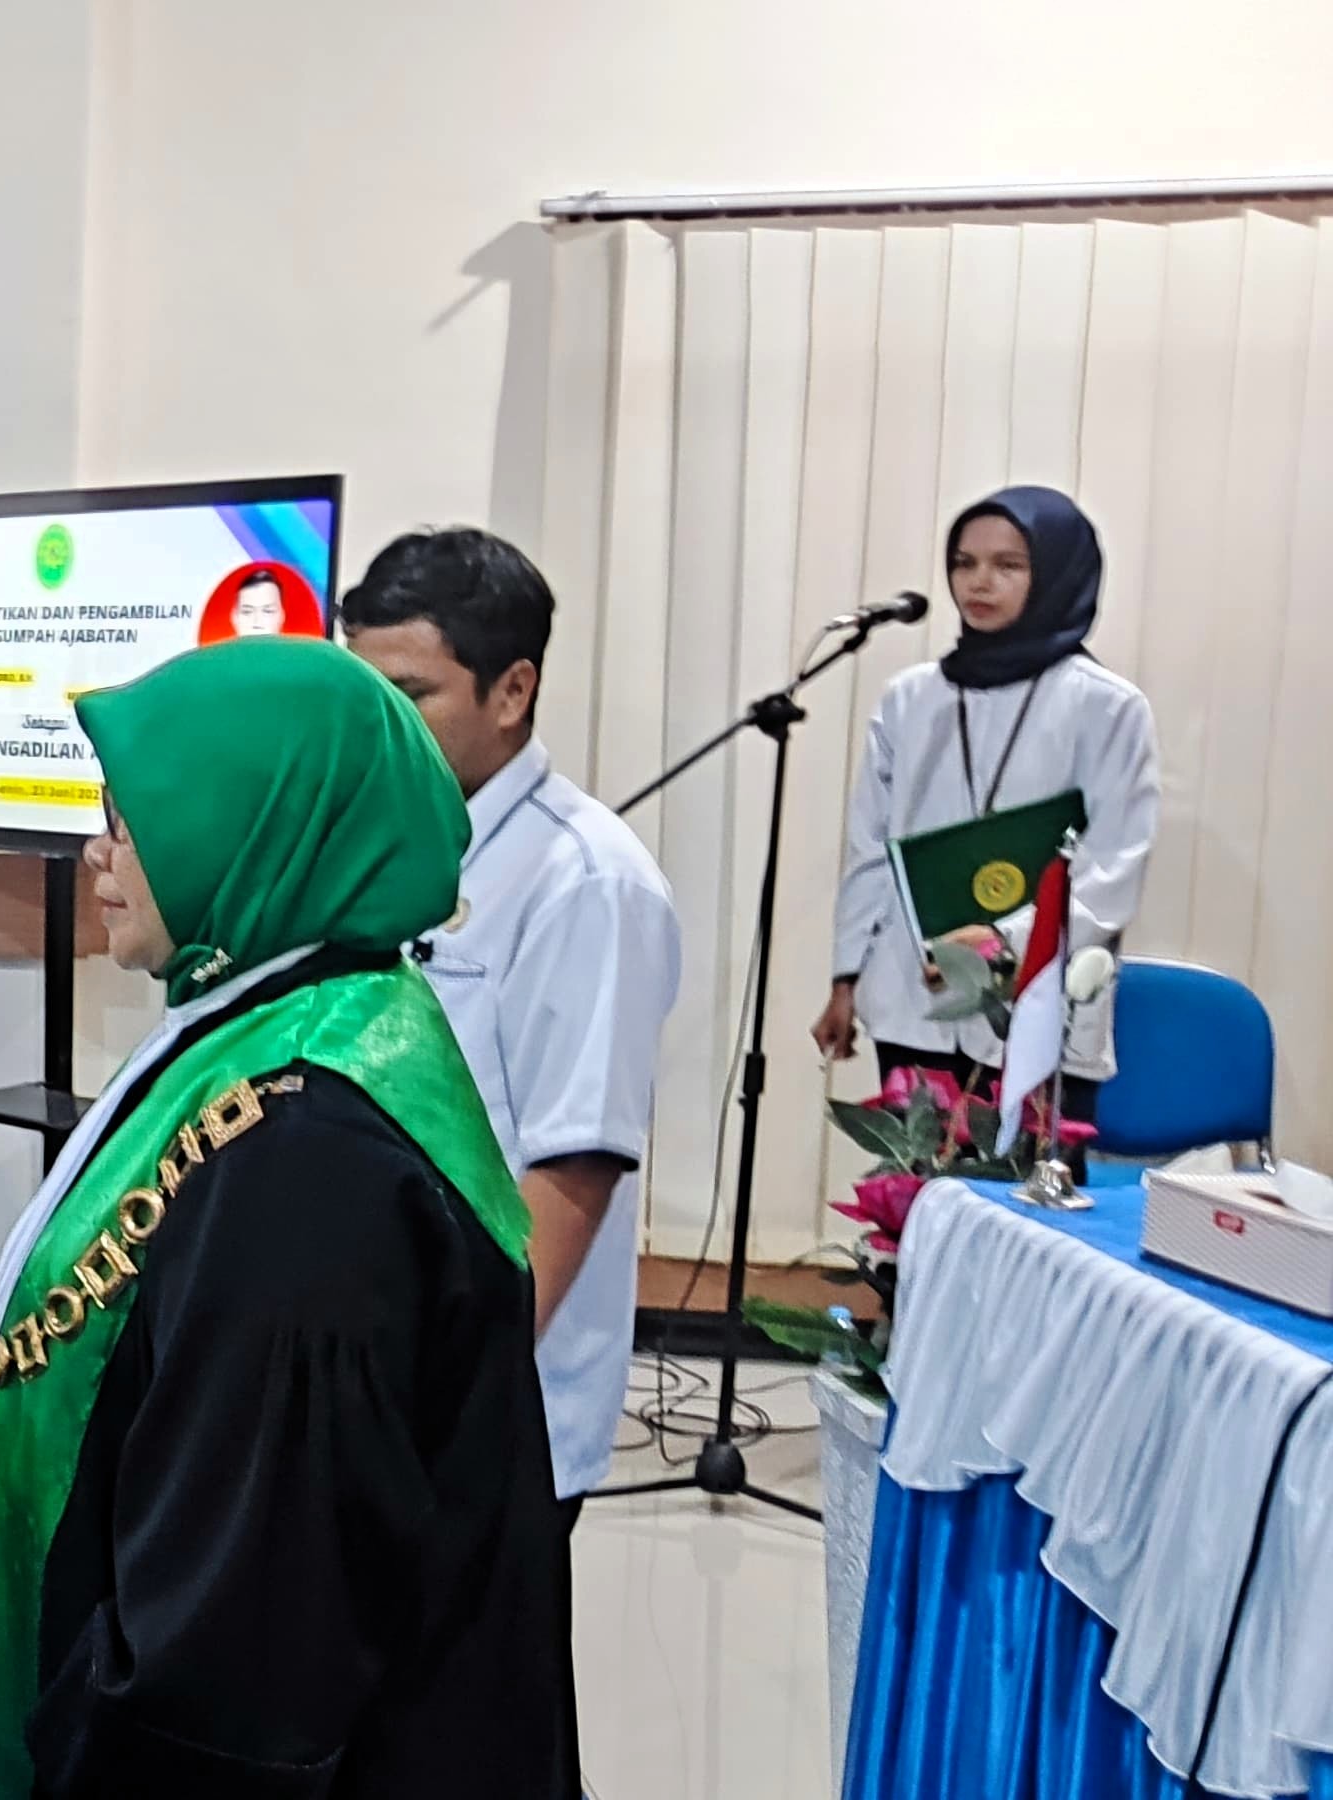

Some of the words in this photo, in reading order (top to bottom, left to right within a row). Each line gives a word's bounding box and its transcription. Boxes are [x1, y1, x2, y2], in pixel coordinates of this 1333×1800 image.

[42, 606, 74, 620] DAN
[79, 604, 193, 620] PENGAMBILAN
[60, 629, 138, 646] AJABATAN
[21, 713, 71, 736] Sebagai
[77, 787, 100, 801] 202
